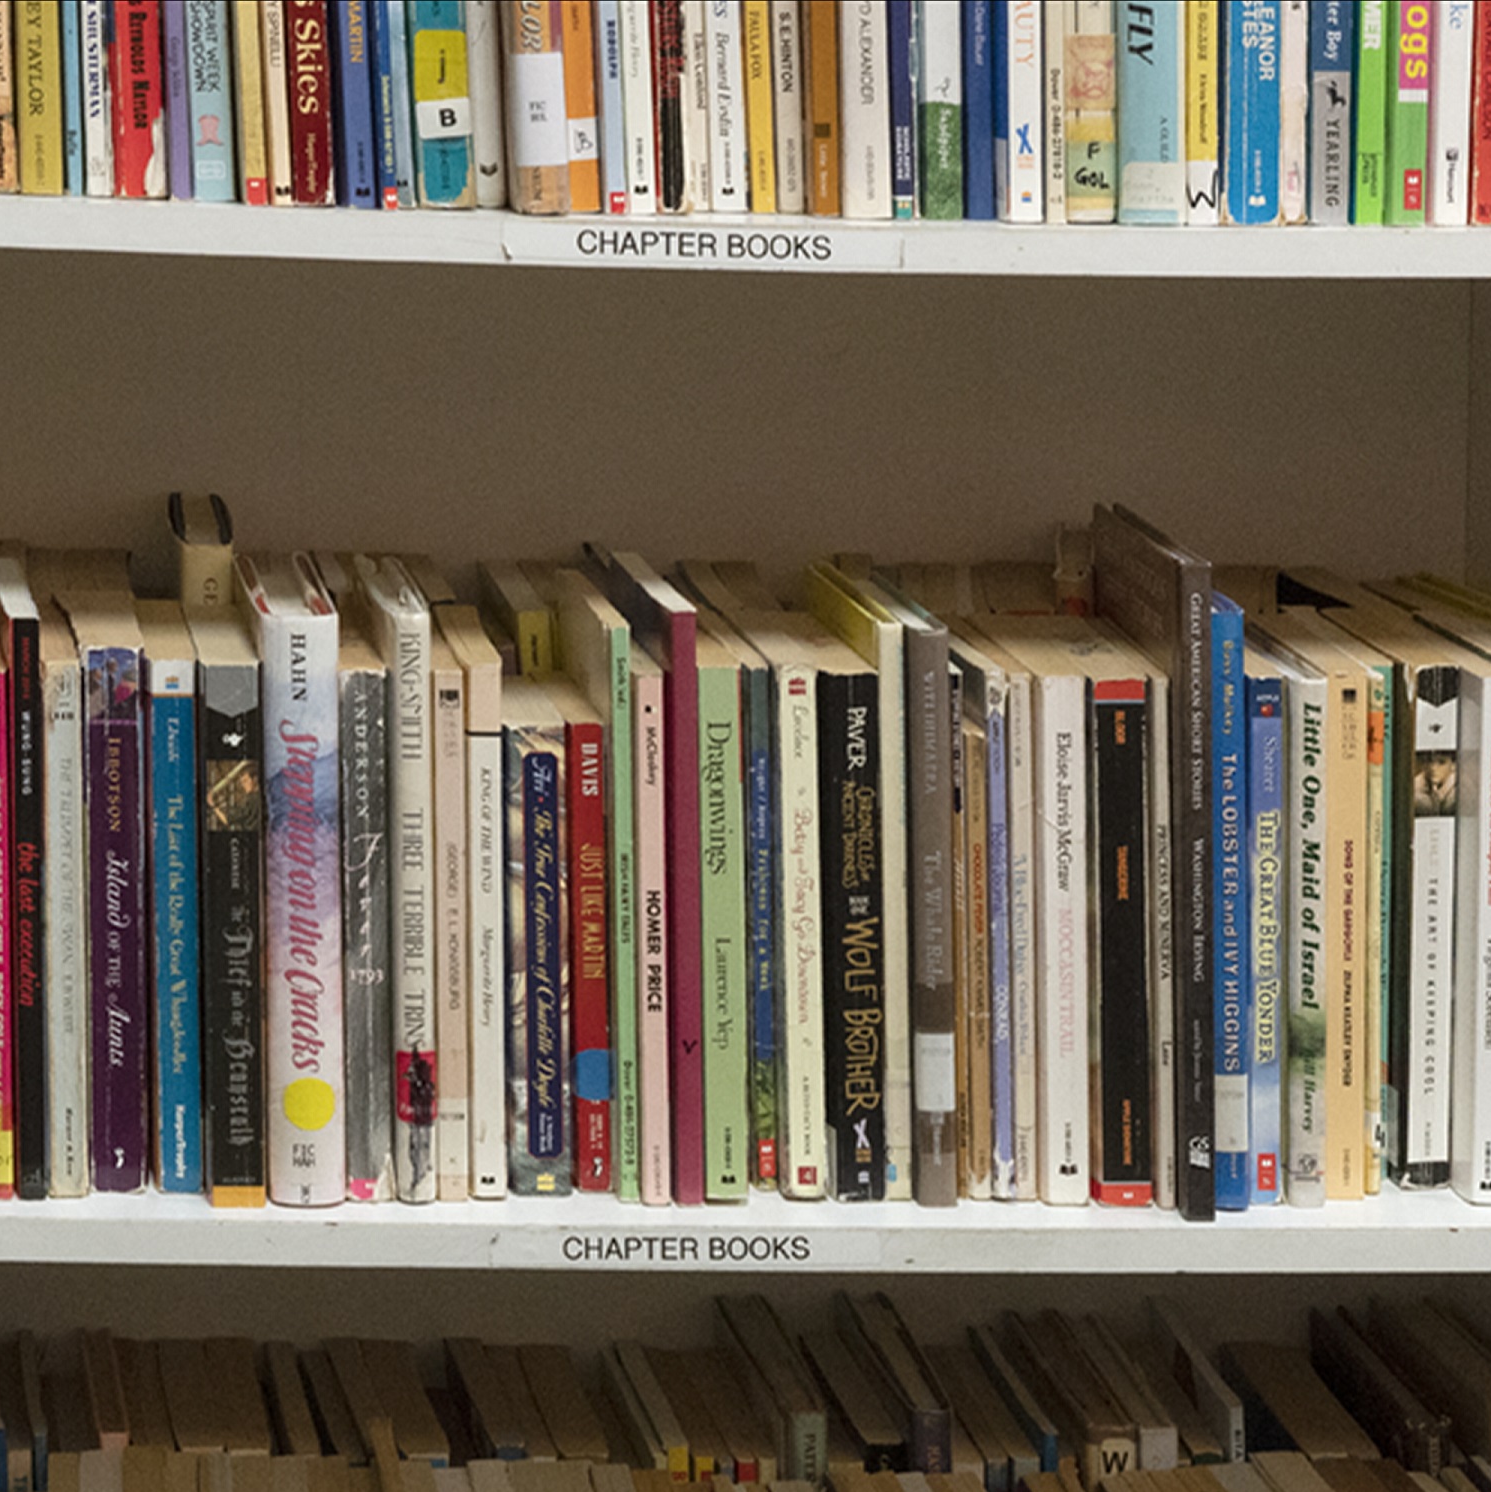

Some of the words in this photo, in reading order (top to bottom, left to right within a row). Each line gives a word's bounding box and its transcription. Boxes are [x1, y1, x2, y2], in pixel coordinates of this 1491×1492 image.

[1128, 4, 1153, 65] FLY
[295, 19, 320, 114] Skies
[1326, 121, 1341, 206] YEARLING
[577, 228, 717, 259] CHAPTER
[727, 233, 832, 260] BOOKS
[292, 633, 307, 702] HAHN
[400, 633, 422, 761] KING-SMITH
[847, 707, 866, 769] PAVER
[1300, 702, 1321, 768] Little
[106, 736, 122, 832] IBBOTSON
[280, 720, 319, 868] Stepping
[581, 743, 599, 796] DAVIS
[705, 722, 732, 873] Dragonwings
[17, 843, 38, 874] the
[402, 809, 424, 872] THREE
[579, 843, 602, 877] JUST
[1258, 812, 1278, 851] THE
[17, 878, 38, 914] last
[106, 850, 131, 927] Island
[291, 872, 314, 904] on
[580, 882, 603, 914] LIKE
[1258, 857, 1278, 921] GREAT
[1301, 840, 1321, 899] Maid
[108, 931, 121, 952] OF
[291, 909, 320, 962] the
[402, 888, 425, 975] TERRIBLE
[581, 918, 604, 978] MARTIN
[646, 890, 662, 955] HOMER
[1258, 924, 1278, 975] BLUE
[1301, 907, 1321, 934] of
[17, 919, 40, 1006] execution
[105, 956, 122, 987] THE
[646, 964, 662, 1011] PRICE
[715, 938, 733, 1011] Laurence
[844, 919, 878, 1001] WOLF
[1301, 940, 1321, 1008] Israel
[108, 994, 132, 1067] Aunts
[288, 969, 325, 1070] Cracks
[712, 1015, 731, 1049] Yep
[1258, 979, 1278, 1062] YONDER
[845, 1010, 881, 1114] BROTHER
[562, 1236, 699, 1261] CHAPTER
[708, 1236, 811, 1261] BOOKS
